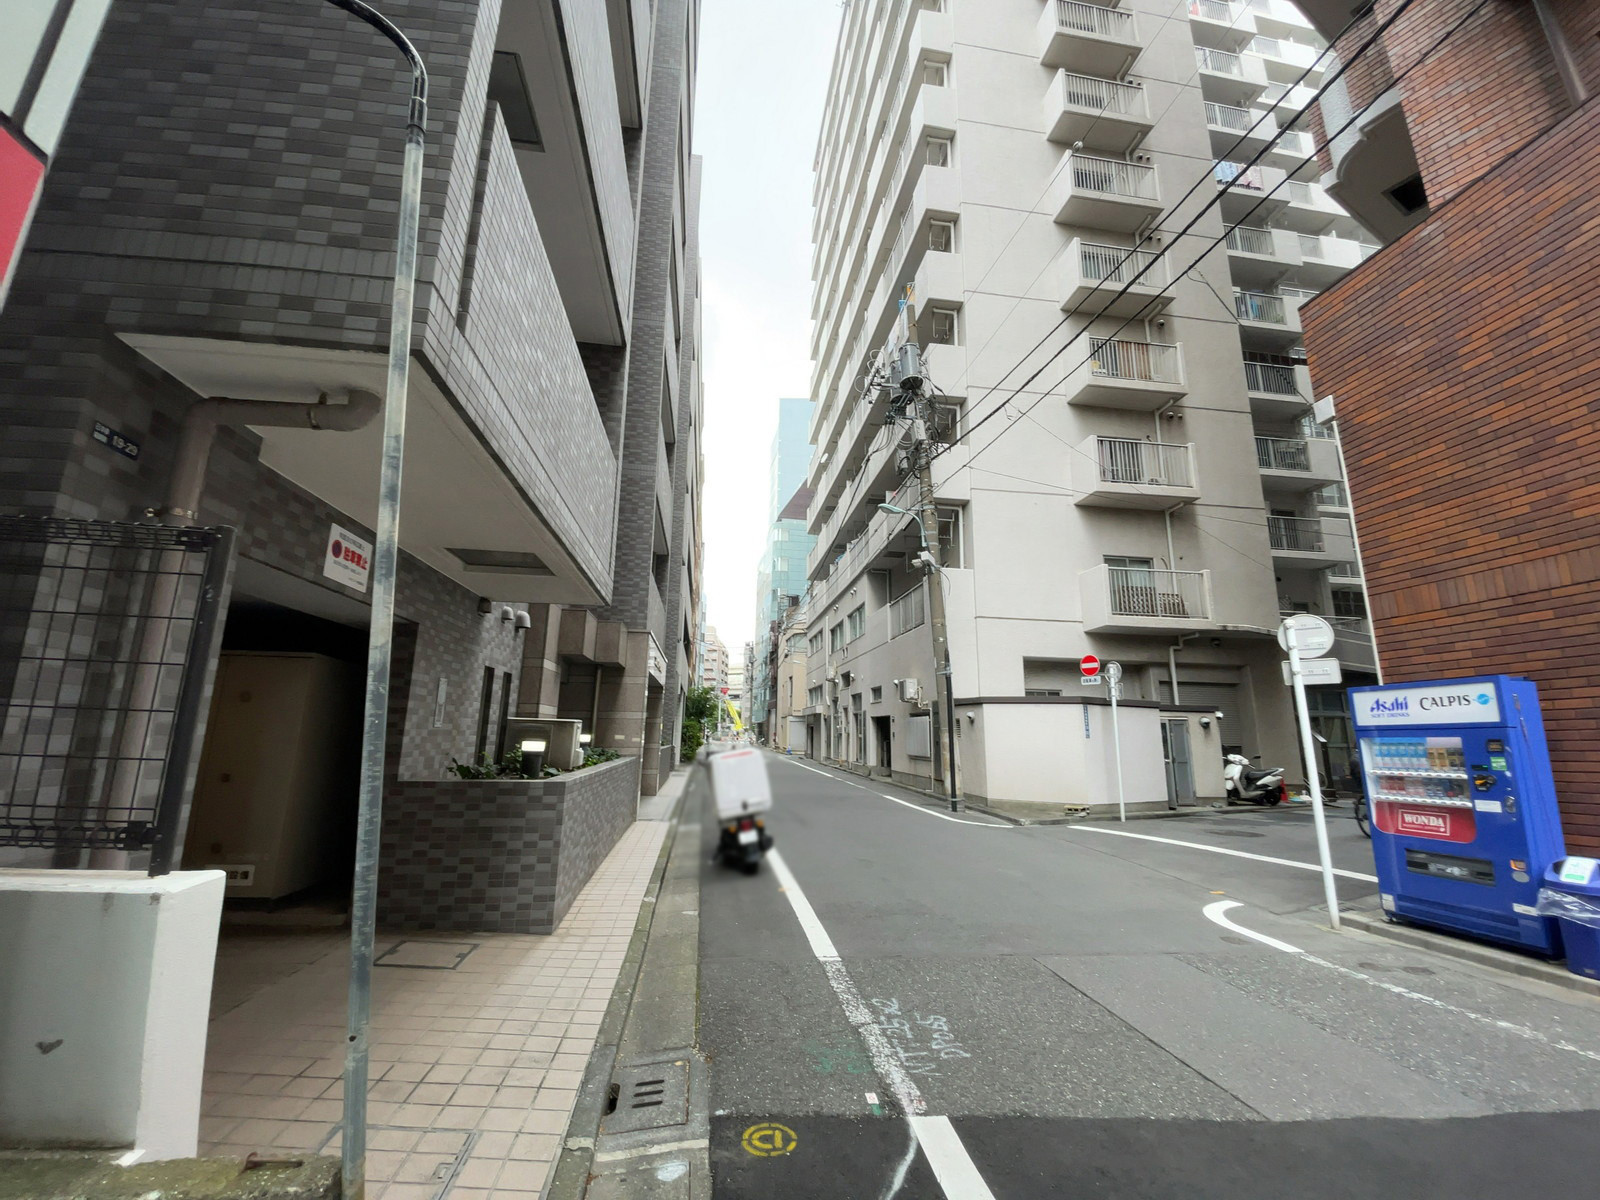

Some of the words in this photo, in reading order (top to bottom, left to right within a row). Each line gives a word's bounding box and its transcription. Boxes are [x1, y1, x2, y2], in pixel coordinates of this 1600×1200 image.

[1370, 696, 1409, 712] Asahi
[1420, 695, 1471, 711] CALPIS
[1403, 813, 1445, 827] WONDA
